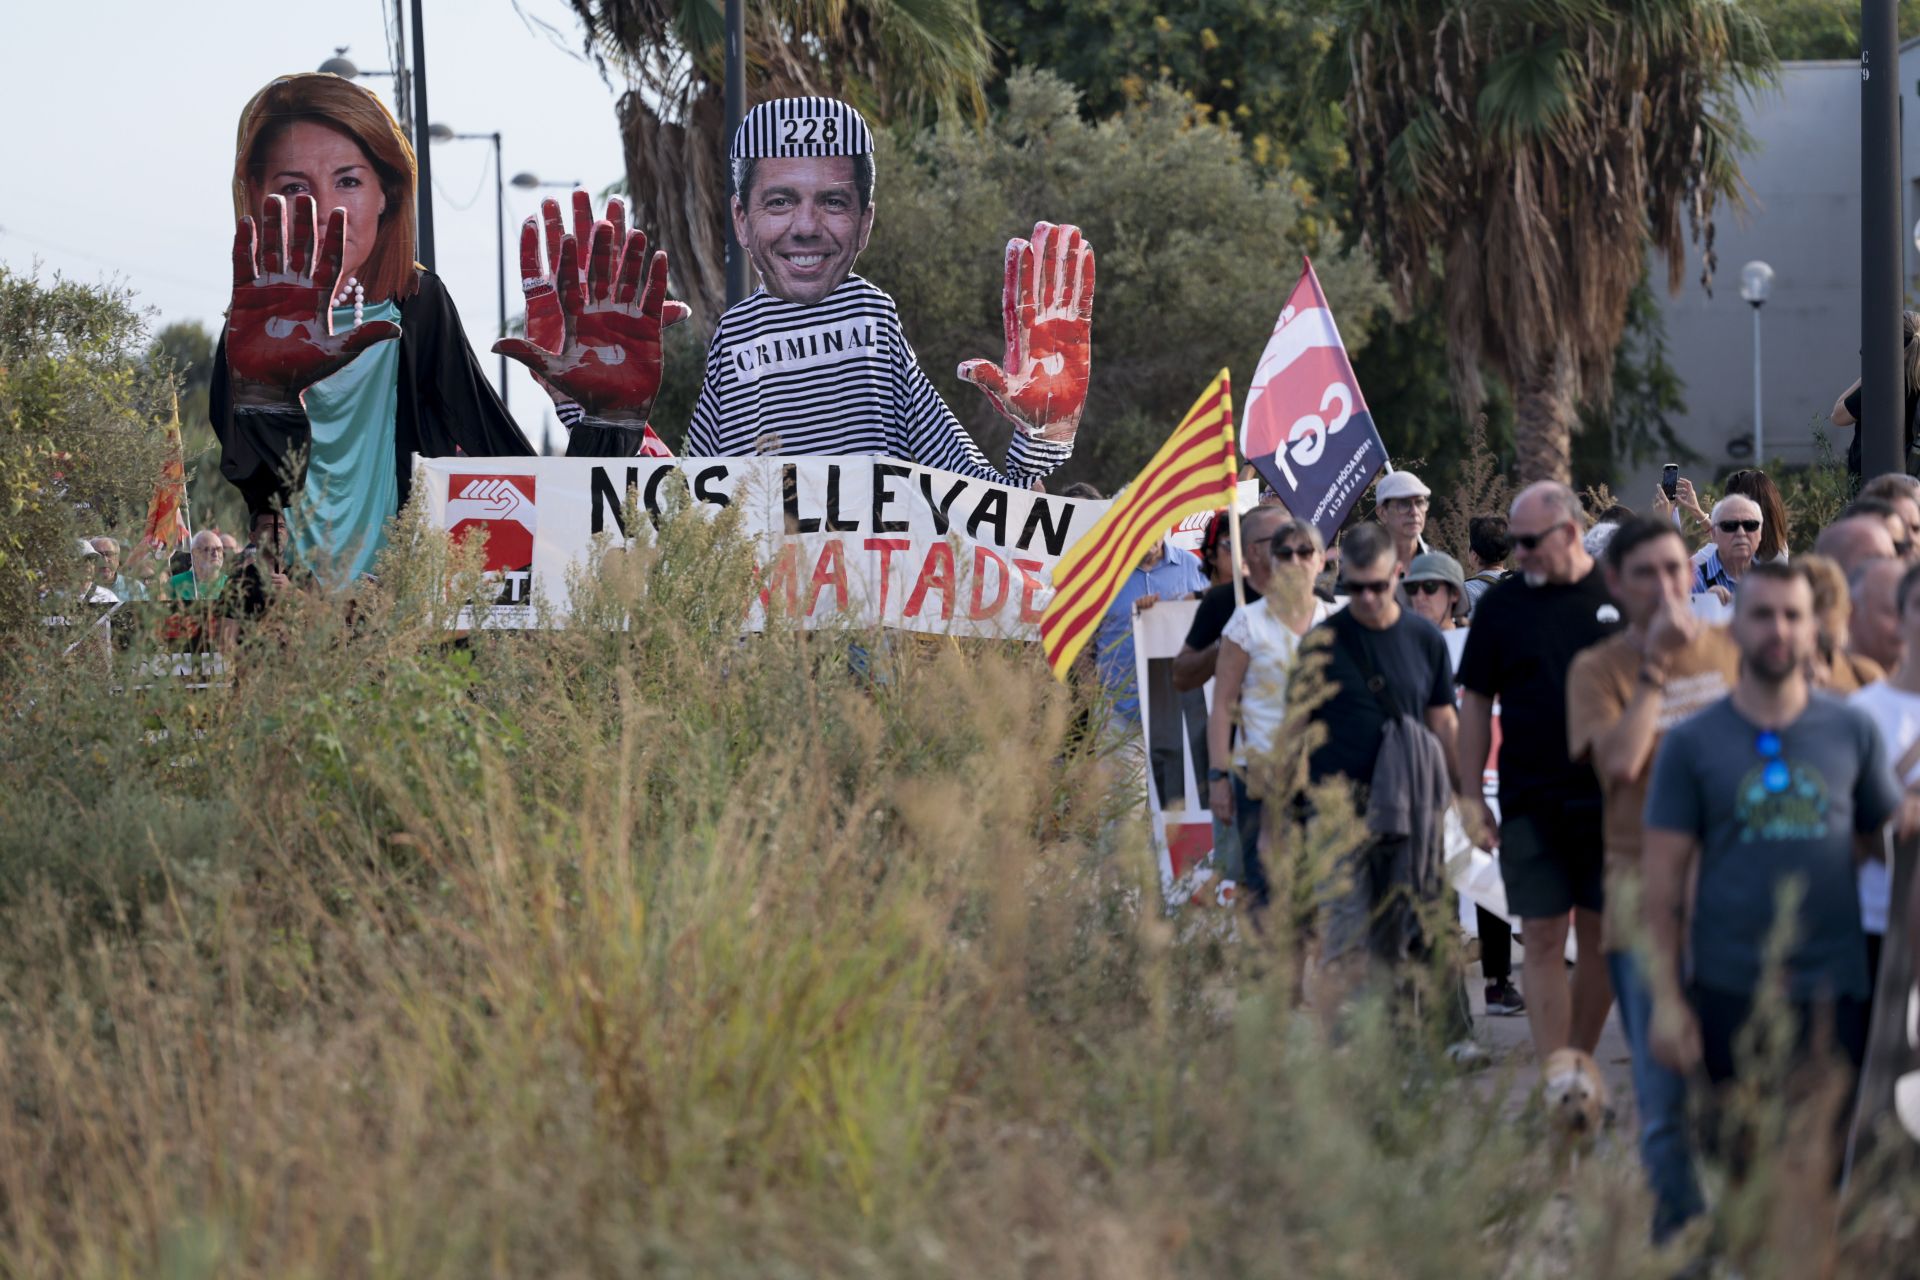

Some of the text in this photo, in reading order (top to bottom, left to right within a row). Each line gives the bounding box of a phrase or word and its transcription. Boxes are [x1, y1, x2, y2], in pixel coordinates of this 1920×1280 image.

[1862, 50, 1869, 64] C
[1862, 67, 1870, 81] 9
[783, 118, 838, 144] 228
[736, 324, 875, 372] CRIMINAL
[590, 462, 1076, 557] NOS LLEVAN
